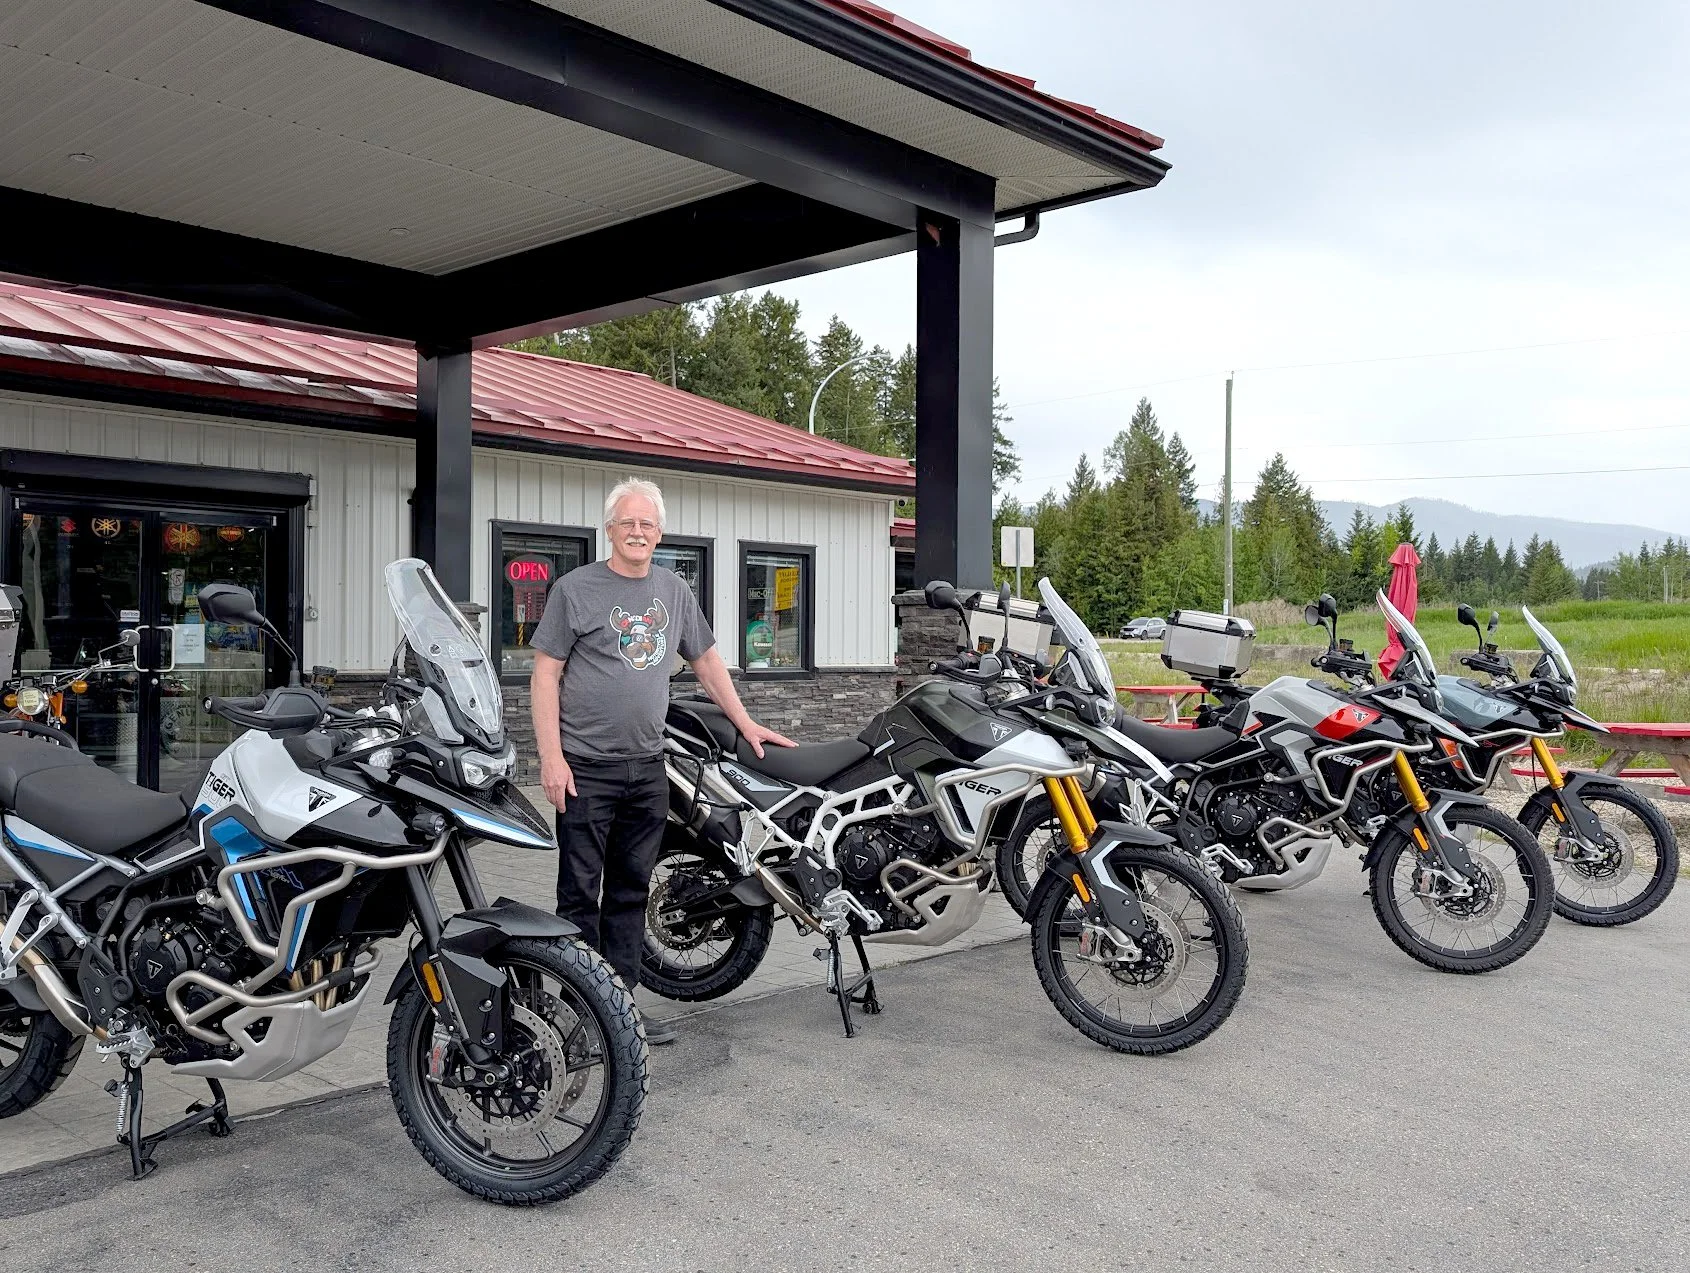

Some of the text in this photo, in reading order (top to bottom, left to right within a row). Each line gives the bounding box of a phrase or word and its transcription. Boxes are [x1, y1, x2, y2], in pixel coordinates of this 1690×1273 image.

[510, 561, 548, 581] OPEN
[205, 771, 236, 802] TIGER
[728, 769, 751, 786] 900
[958, 780, 1002, 796] GER
